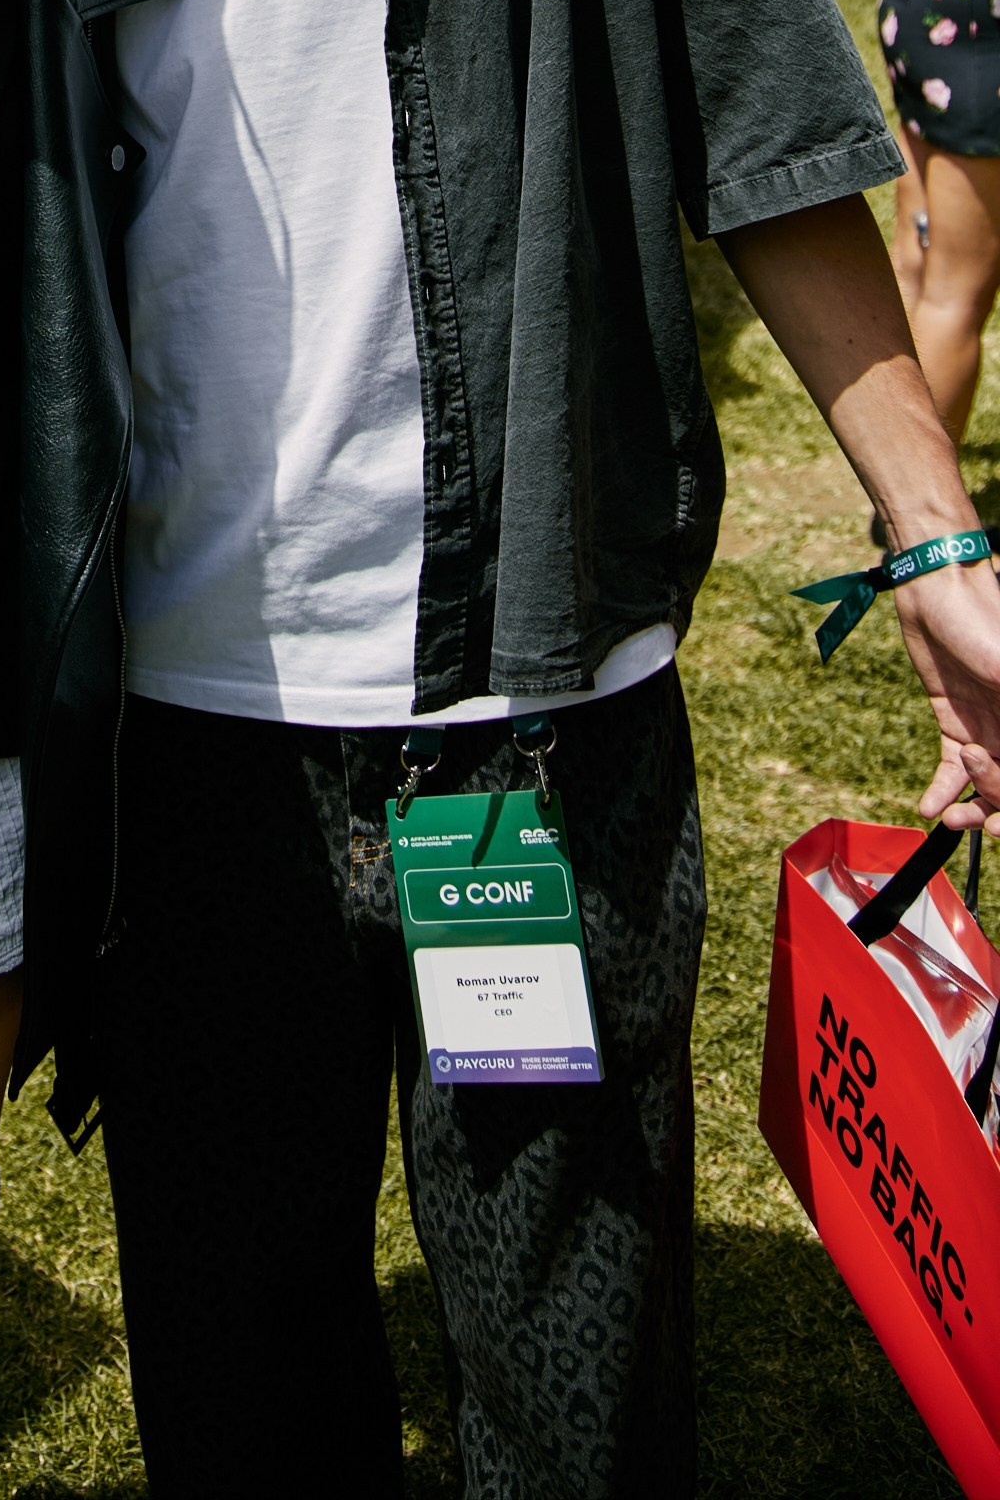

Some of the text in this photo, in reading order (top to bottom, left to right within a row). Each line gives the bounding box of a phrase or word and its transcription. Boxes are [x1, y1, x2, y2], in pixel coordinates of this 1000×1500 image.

[926, 537, 975, 564] CONF
[410, 840, 452, 848] CONFERENCE
[441, 833, 473, 841] BUSINESS
[439, 880, 534, 906] G CONF
[456, 974, 540, 987] Roman Uvarov
[477, 991, 524, 1001] 67 Traffic
[494, 1008, 513, 1017] CEO
[819, 992, 877, 1089] NO
[455, 1056, 515, 1070] PAYGURU
[815, 1030, 974, 1328] TRAFFIC.
[808, 1070, 953, 1342] NO BAG.
